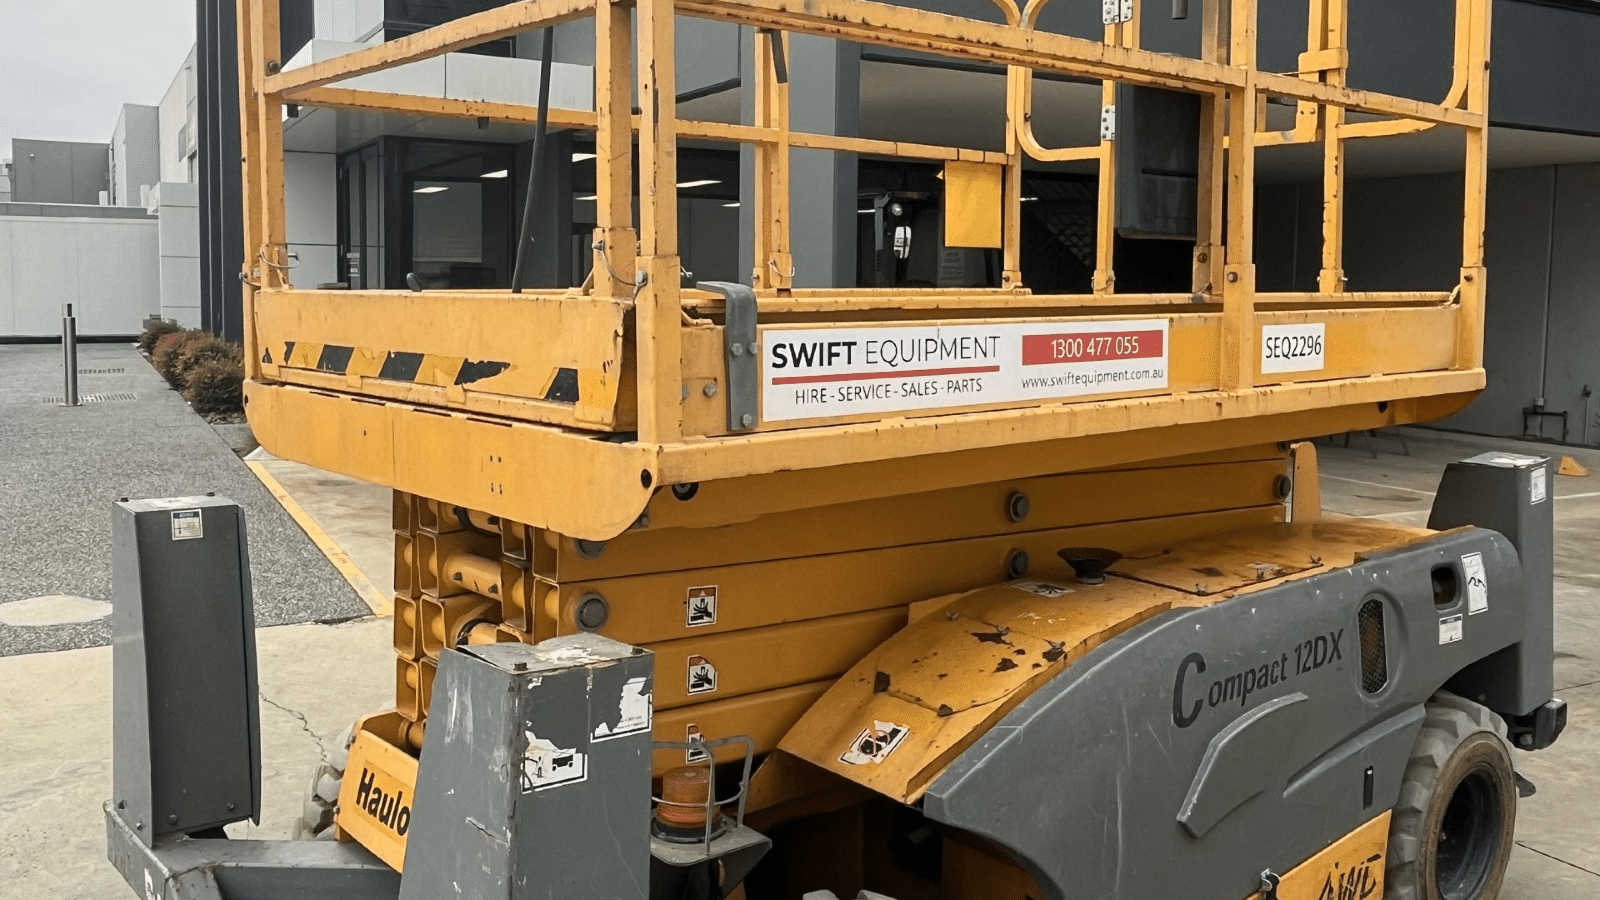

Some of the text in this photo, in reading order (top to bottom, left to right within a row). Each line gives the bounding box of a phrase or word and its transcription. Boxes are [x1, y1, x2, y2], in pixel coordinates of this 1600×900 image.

[772, 336, 1000, 368] SWIFT EQUIPMENT
[1051, 336, 1139, 358] 1300 477 055
[1265, 335, 1322, 359] SEQ2296
[795, 388, 827, 405] HIRE
[838, 384, 891, 402] SERVICE
[901, 381, 938, 397] SALES
[947, 378, 982, 394] PARTS
[1021, 368, 1164, 389] www.swiftequipment.com.au
[1172, 628, 1344, 729] Compact 12DX
[356, 767, 411, 836] Haulo
